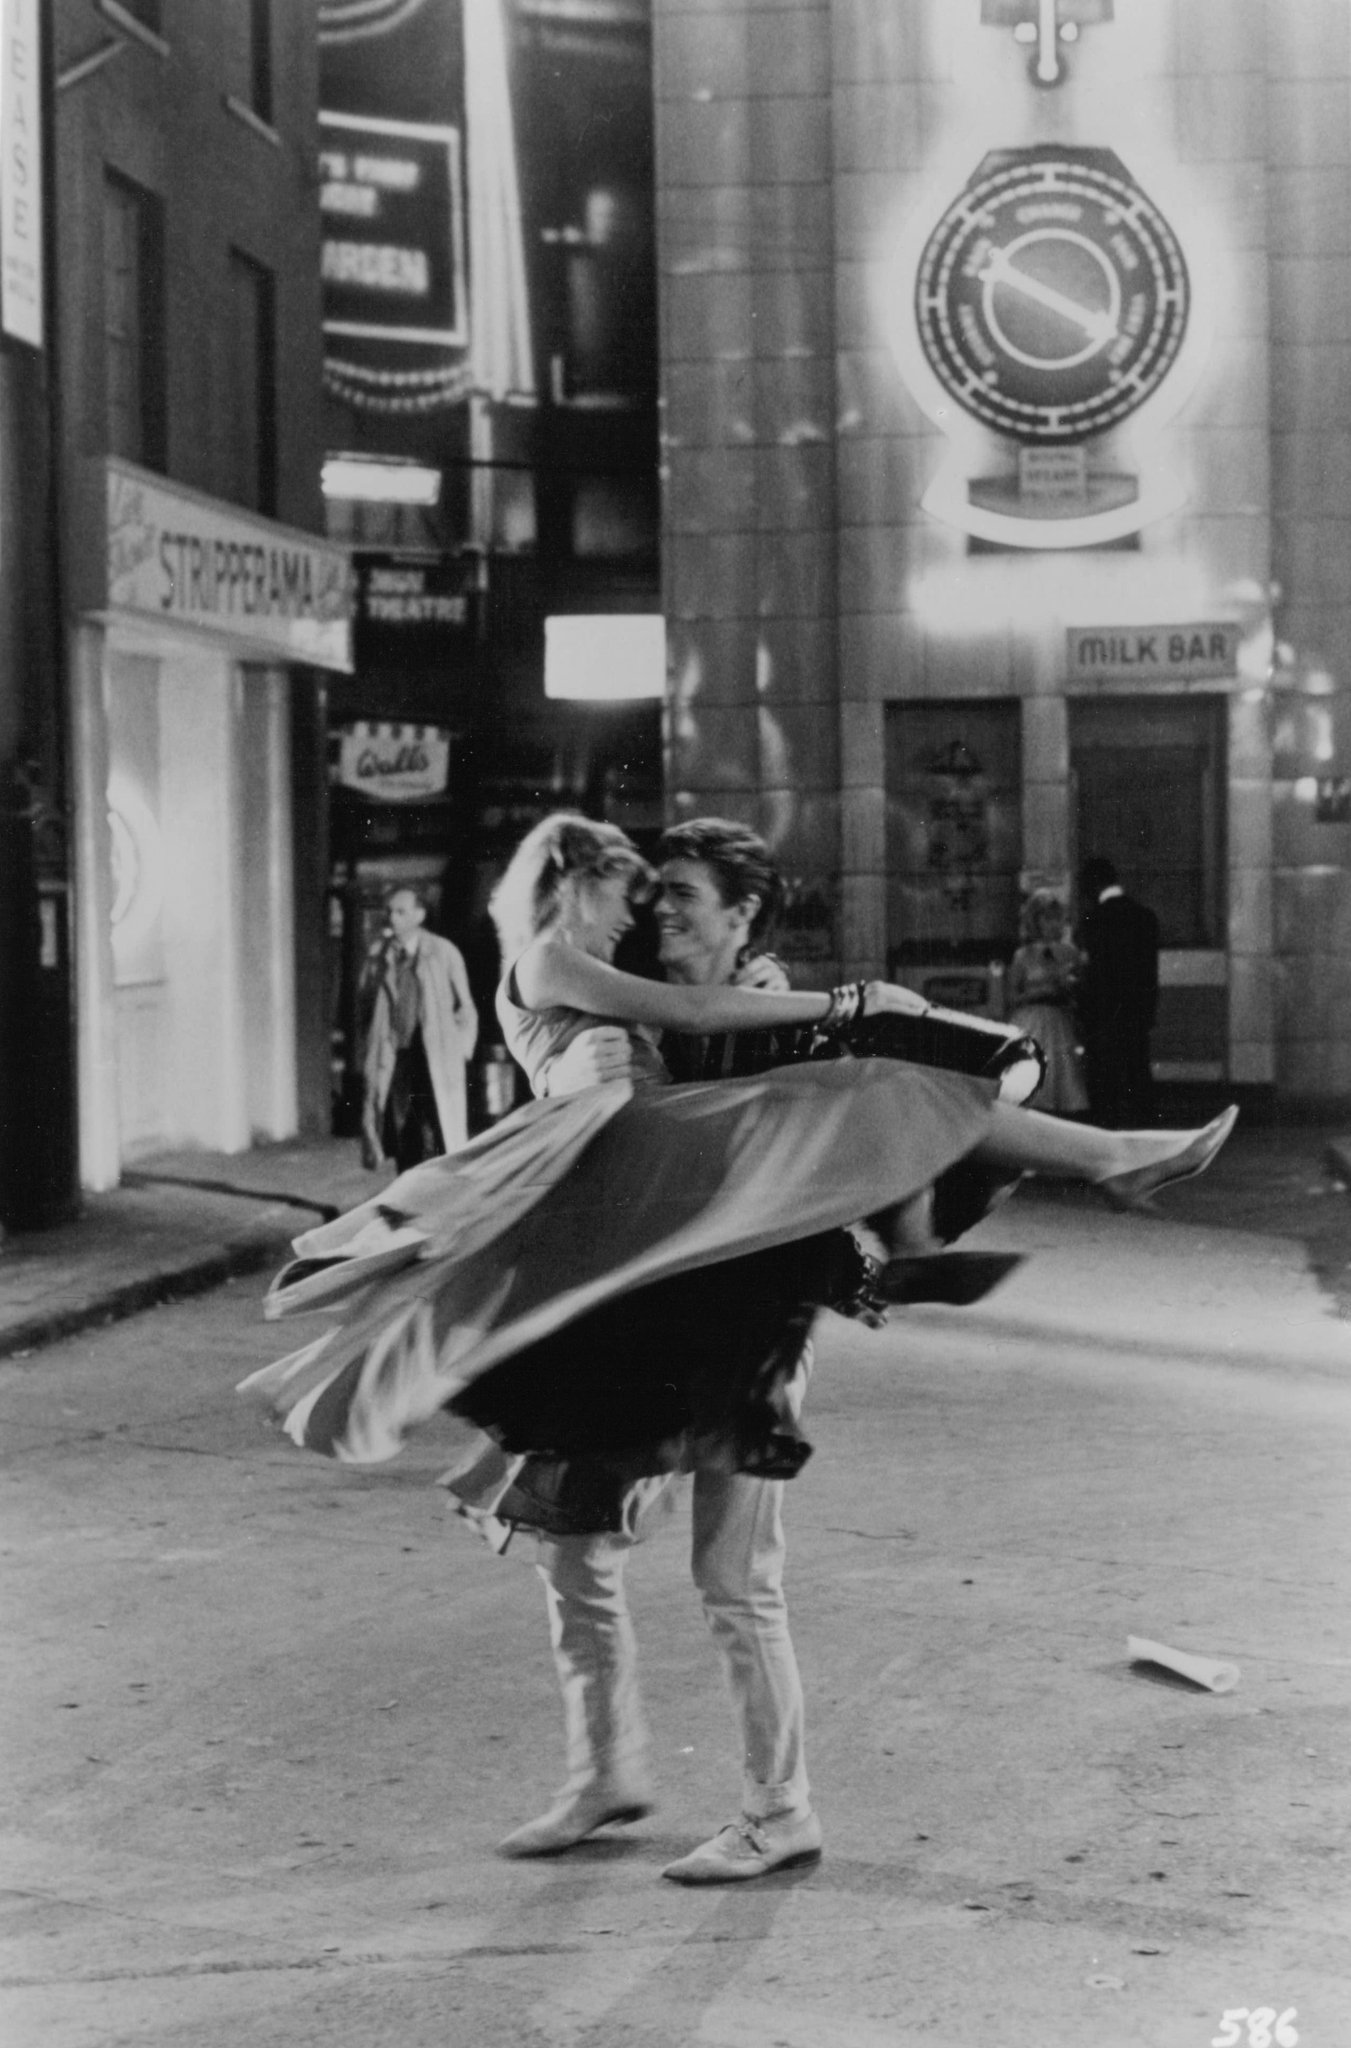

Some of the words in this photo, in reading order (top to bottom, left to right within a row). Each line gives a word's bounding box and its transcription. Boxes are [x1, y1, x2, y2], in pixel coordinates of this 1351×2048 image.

[160, 531, 319, 618] STRIPPERAMA
[368, 597, 467, 622] THEATRE
[1078, 635, 1158, 665] MILK
[1167, 633, 1226, 663] BAR
